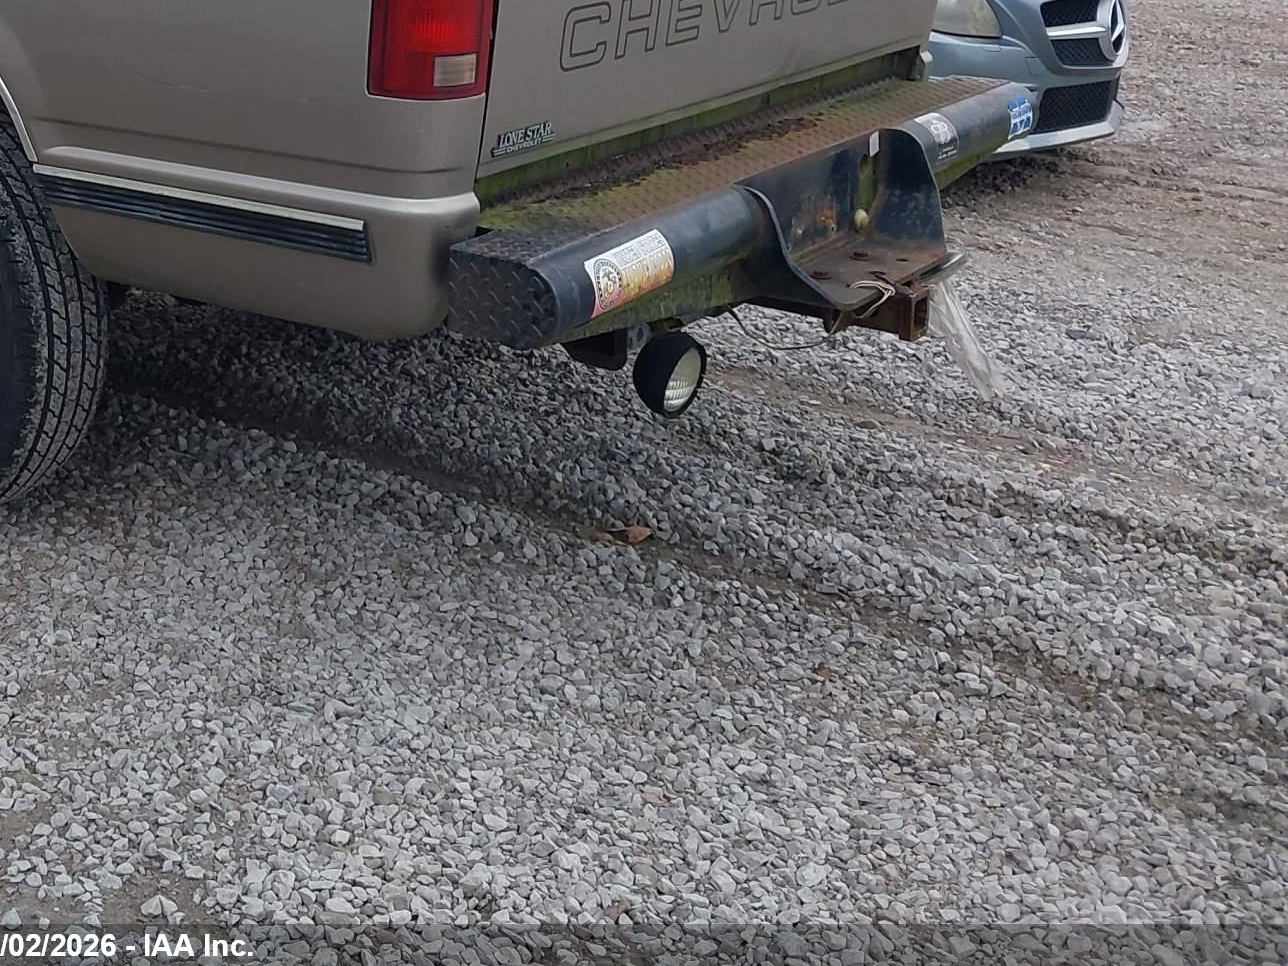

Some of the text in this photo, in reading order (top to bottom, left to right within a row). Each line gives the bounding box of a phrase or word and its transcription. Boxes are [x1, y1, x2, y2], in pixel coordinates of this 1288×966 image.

[498, 121, 552, 148] LONE STAR
[506, 137, 542, 153] CHEVROLET
